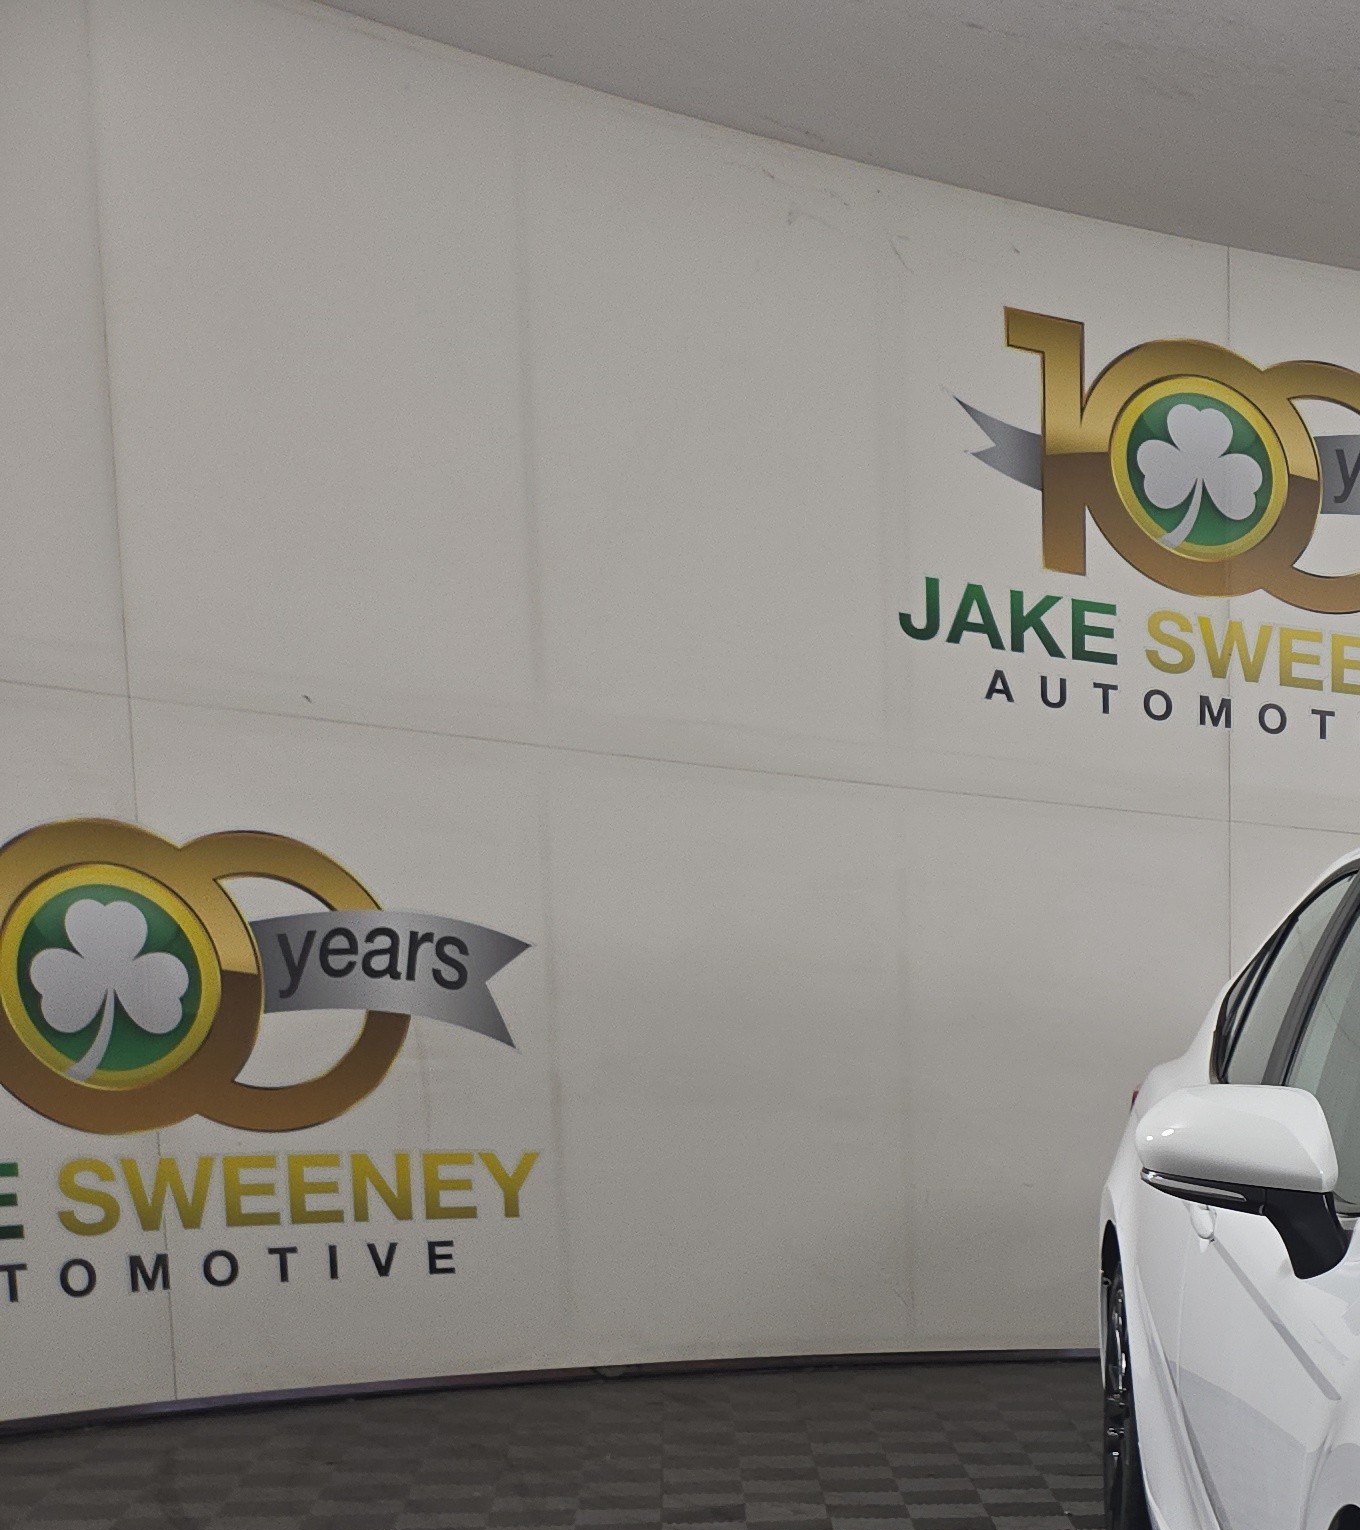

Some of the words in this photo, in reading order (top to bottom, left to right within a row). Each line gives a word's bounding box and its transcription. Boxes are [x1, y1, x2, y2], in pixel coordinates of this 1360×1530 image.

[899, 576, 1119, 665] JAKE
[277, 924, 470, 999] years
[57, 1150, 541, 1238] SWEENEY
[0, 1240, 456, 1304] TOMOTIVE
